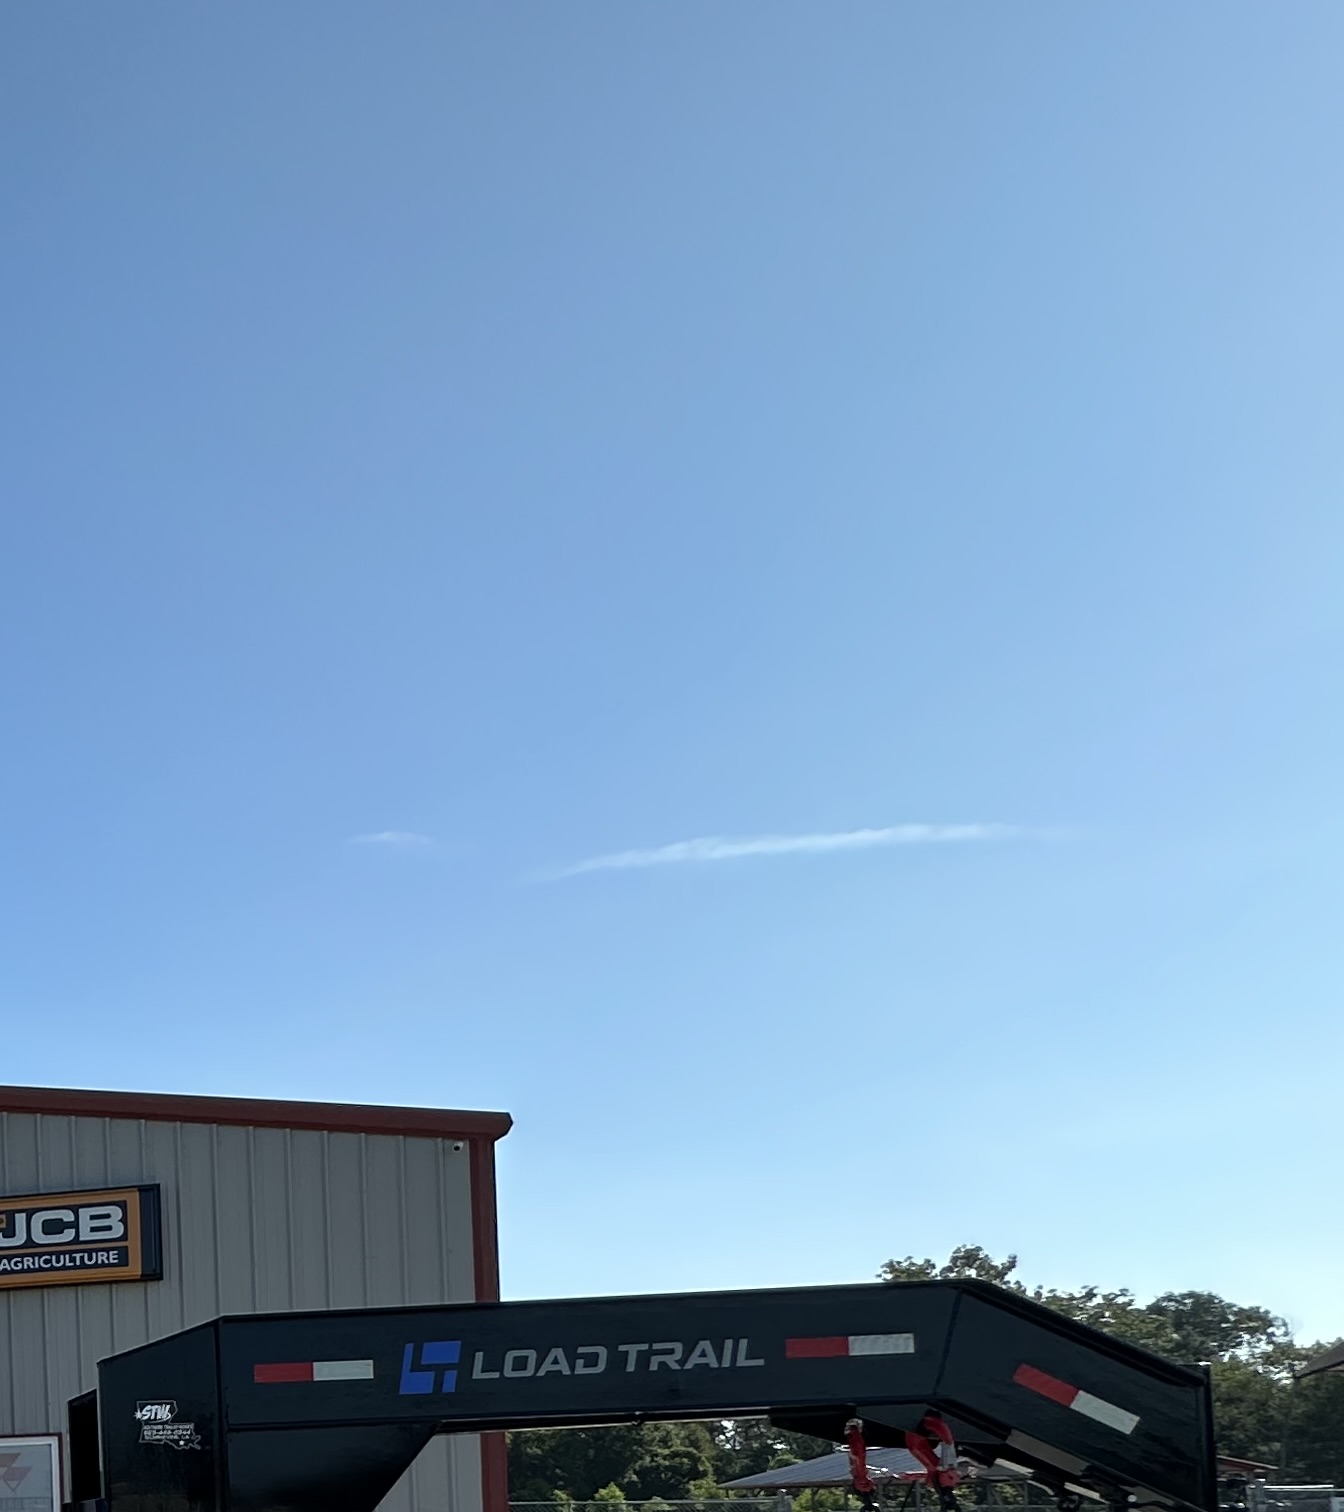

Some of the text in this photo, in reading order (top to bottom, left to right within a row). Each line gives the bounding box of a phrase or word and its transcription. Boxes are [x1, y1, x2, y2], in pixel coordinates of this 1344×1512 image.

[471, 1338, 765, 1379] LOAD TRAIL
[141, 1404, 171, 1420] STW
